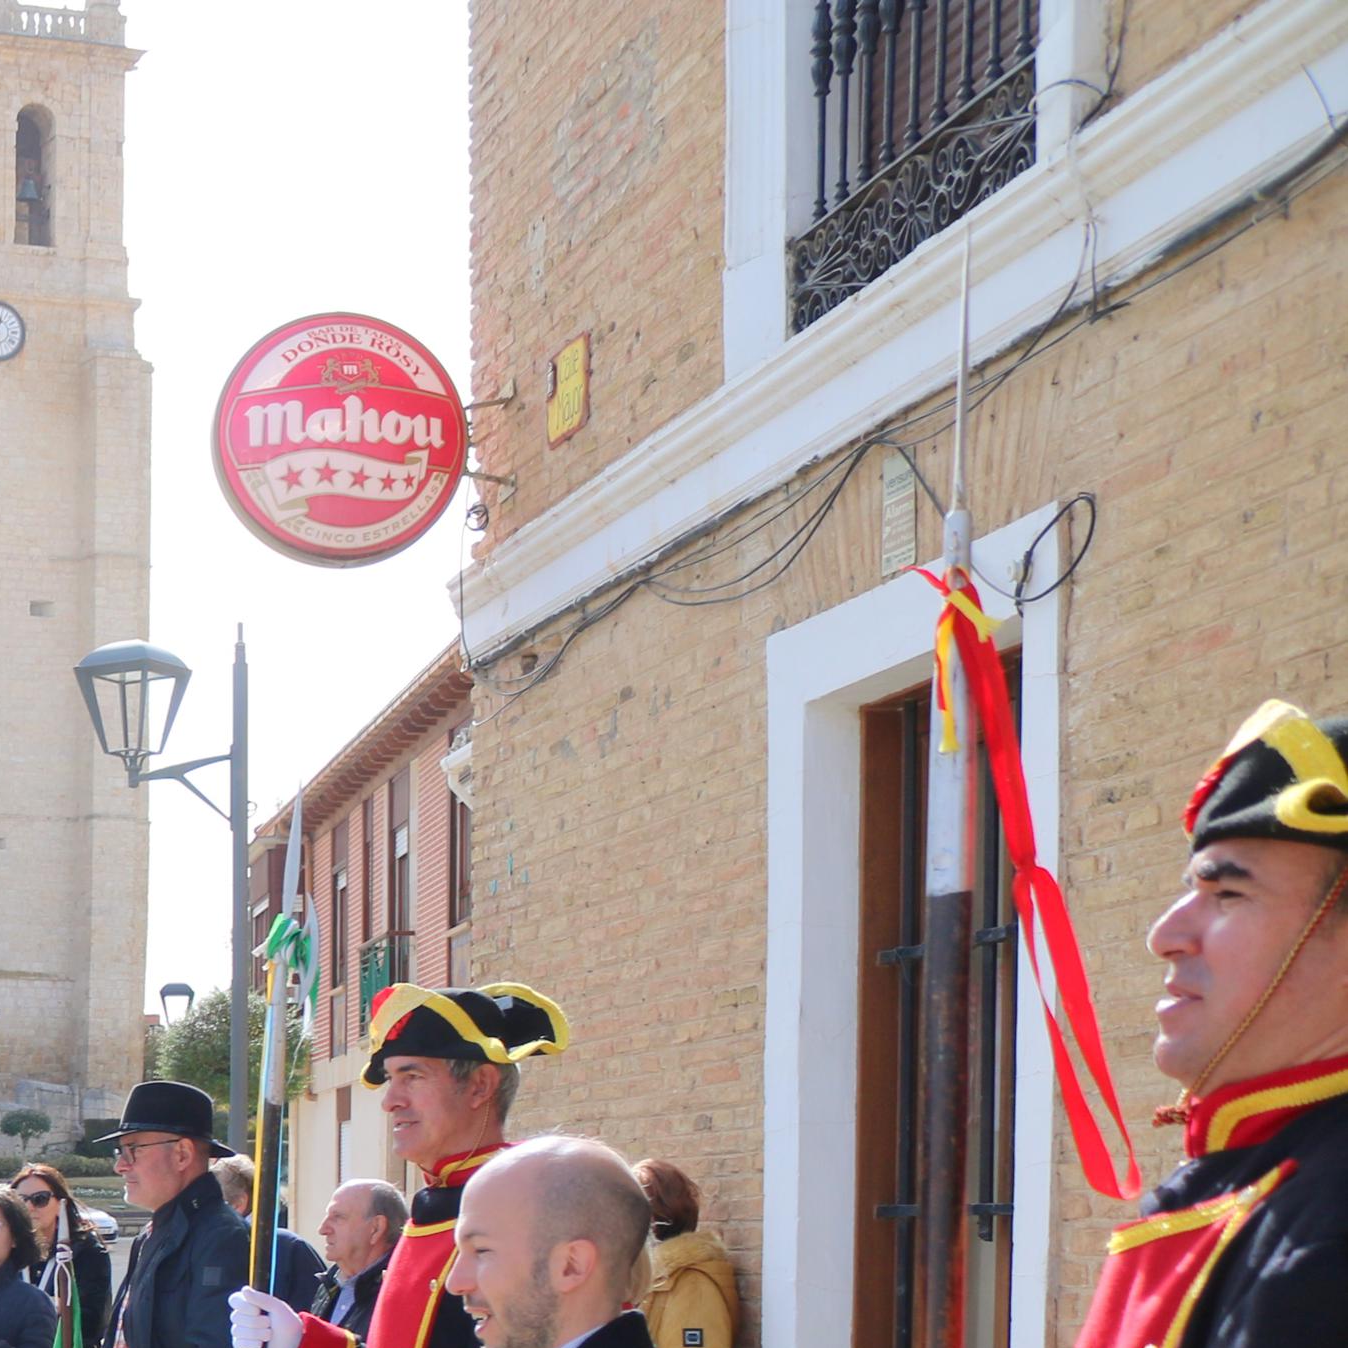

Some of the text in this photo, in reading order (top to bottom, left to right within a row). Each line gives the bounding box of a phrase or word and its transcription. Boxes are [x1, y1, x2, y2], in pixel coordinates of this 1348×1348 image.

[281, 333, 425, 379] DONDE ROSY
[306, 325, 403, 349] BAR DE TAPAS
[304, 486, 439, 544] CINCO ESTRELLAS
